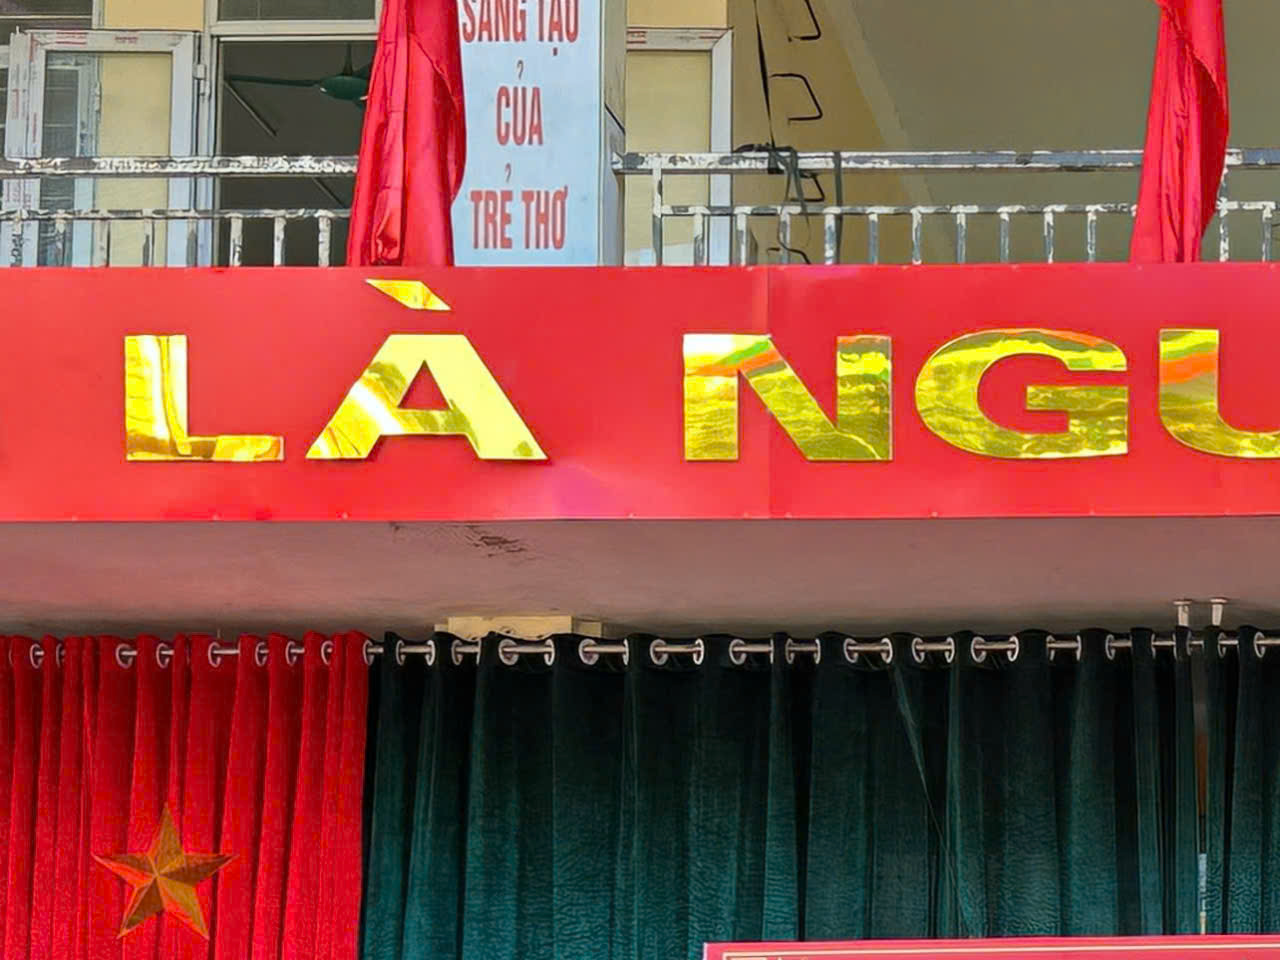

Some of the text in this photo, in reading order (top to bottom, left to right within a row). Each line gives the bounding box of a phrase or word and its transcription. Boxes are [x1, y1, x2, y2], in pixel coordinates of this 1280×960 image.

[496, 60, 543, 146] CỦA
[470, 163, 568, 250] TRẺ THƠ
[124, 279, 548, 462] LÀ
